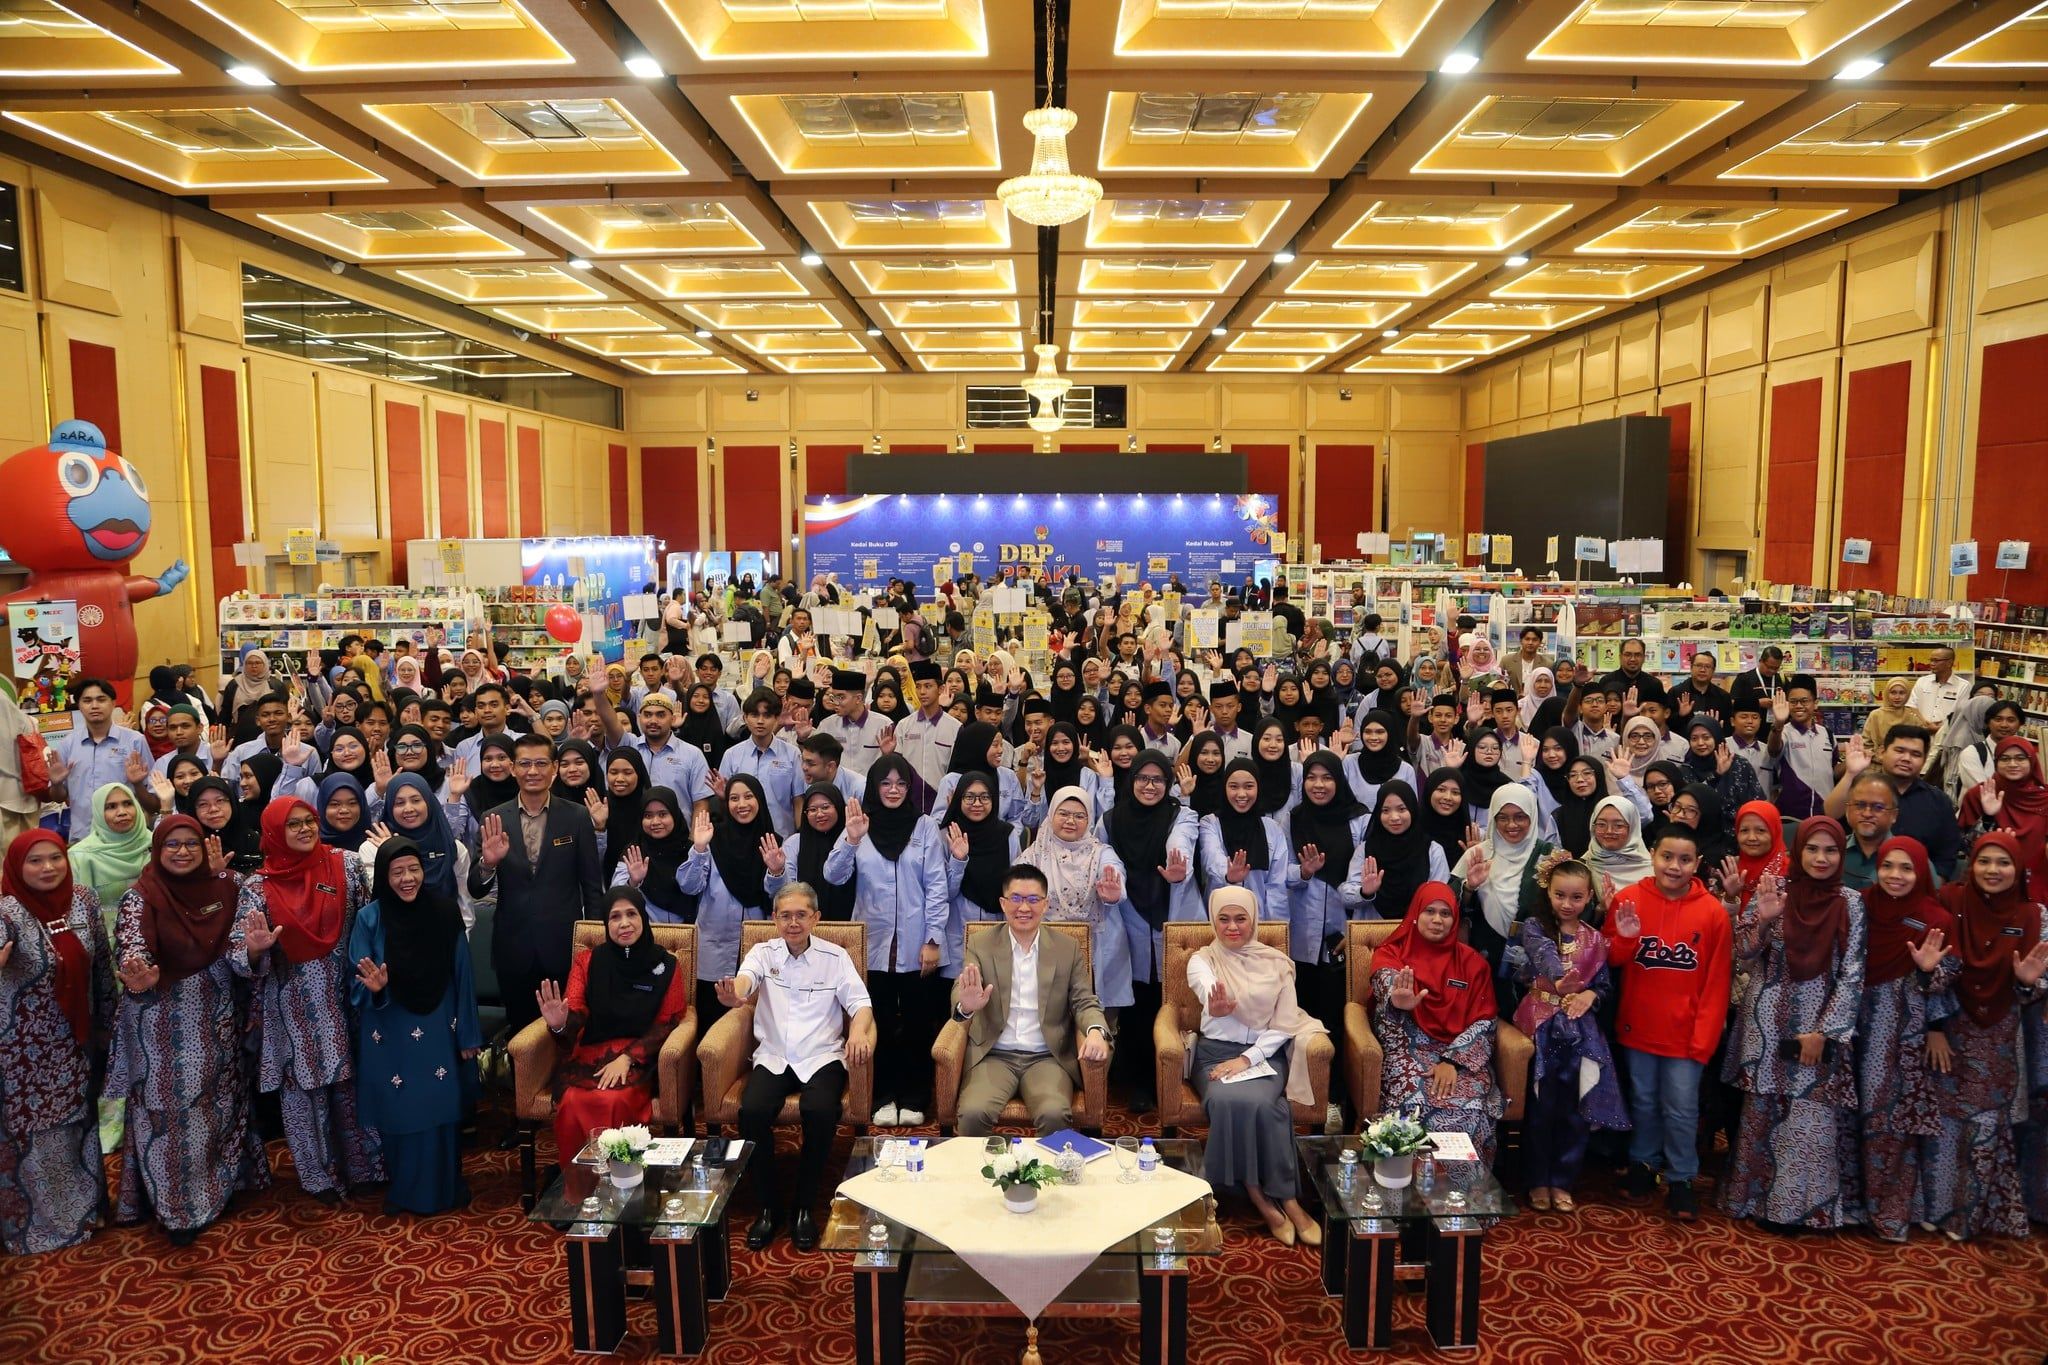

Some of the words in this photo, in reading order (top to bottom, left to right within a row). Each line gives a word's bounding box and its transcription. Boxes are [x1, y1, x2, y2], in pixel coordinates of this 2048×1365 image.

[60, 431, 95, 443] RARA
[999, 543, 1055, 563] DBP
[1055, 554, 1065, 562] di
[18, 649, 39, 663] RARA
